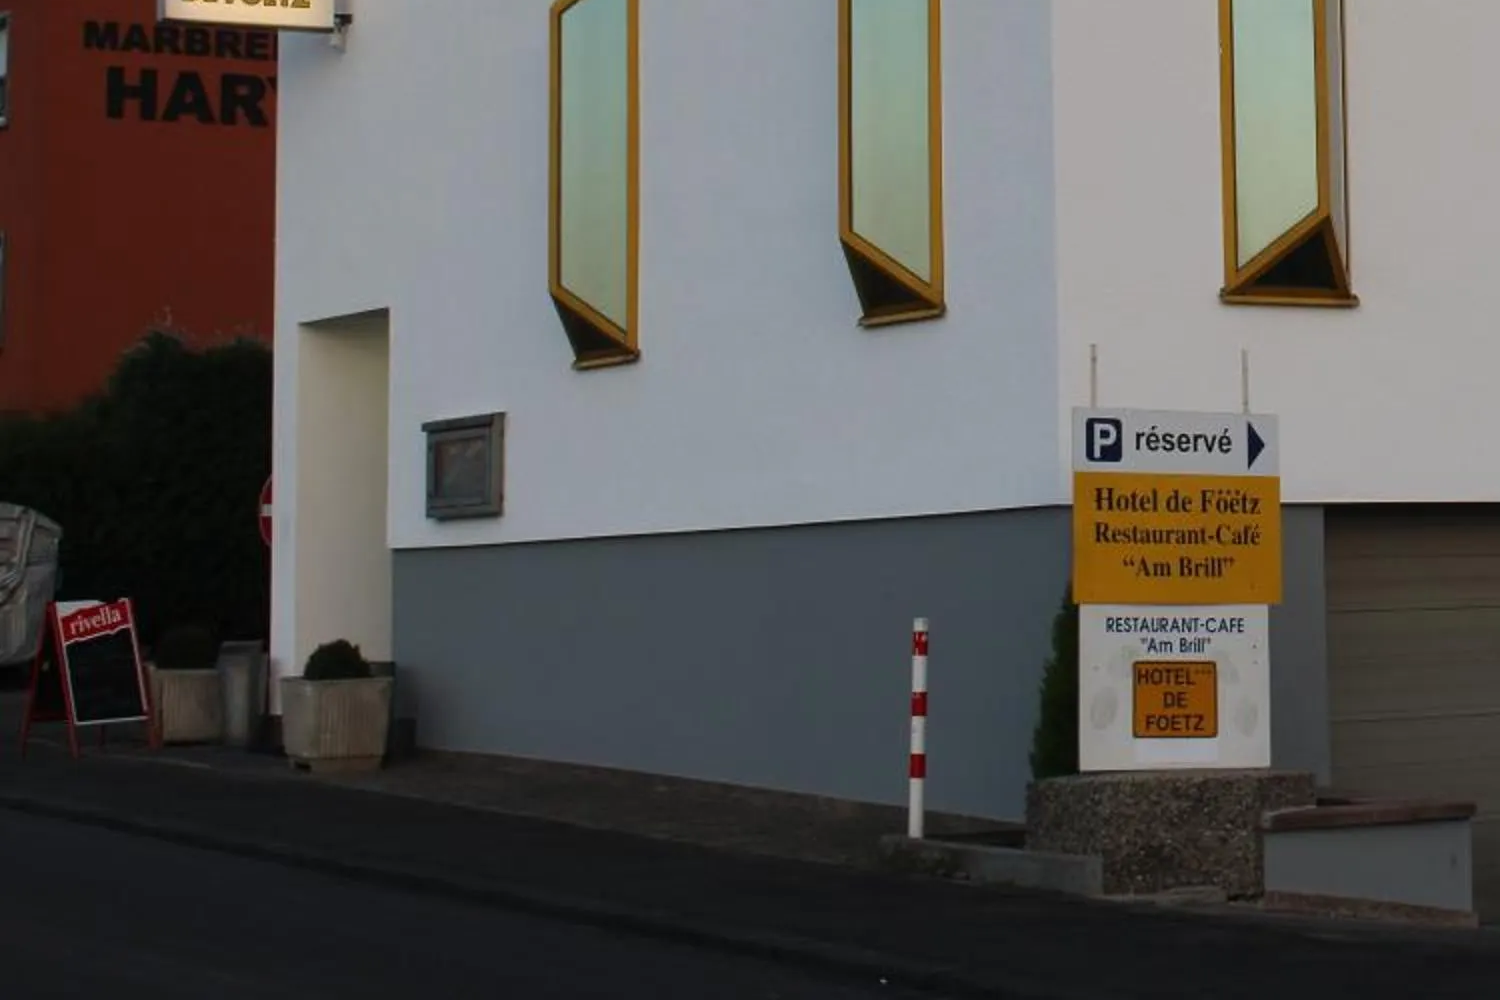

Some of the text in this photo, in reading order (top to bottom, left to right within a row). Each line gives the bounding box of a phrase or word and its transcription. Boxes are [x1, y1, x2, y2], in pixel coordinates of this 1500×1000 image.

[84, 21, 278, 61] MARBRE
[106, 67, 278, 127] HAR
[1092, 422, 1233, 459] P réservé
[1095, 487, 1158, 514] Hotel
[1166, 489, 1193, 514] de
[1095, 521, 1262, 546] Restaurant-Café
[69, 603, 122, 636] rivella
[1105, 617, 1245, 633] RESTAURANT-CAFE
[1137, 668, 1197, 686] HOTEL
[1163, 691, 1189, 709] DE
[1145, 714, 1205, 732] FOETZ
